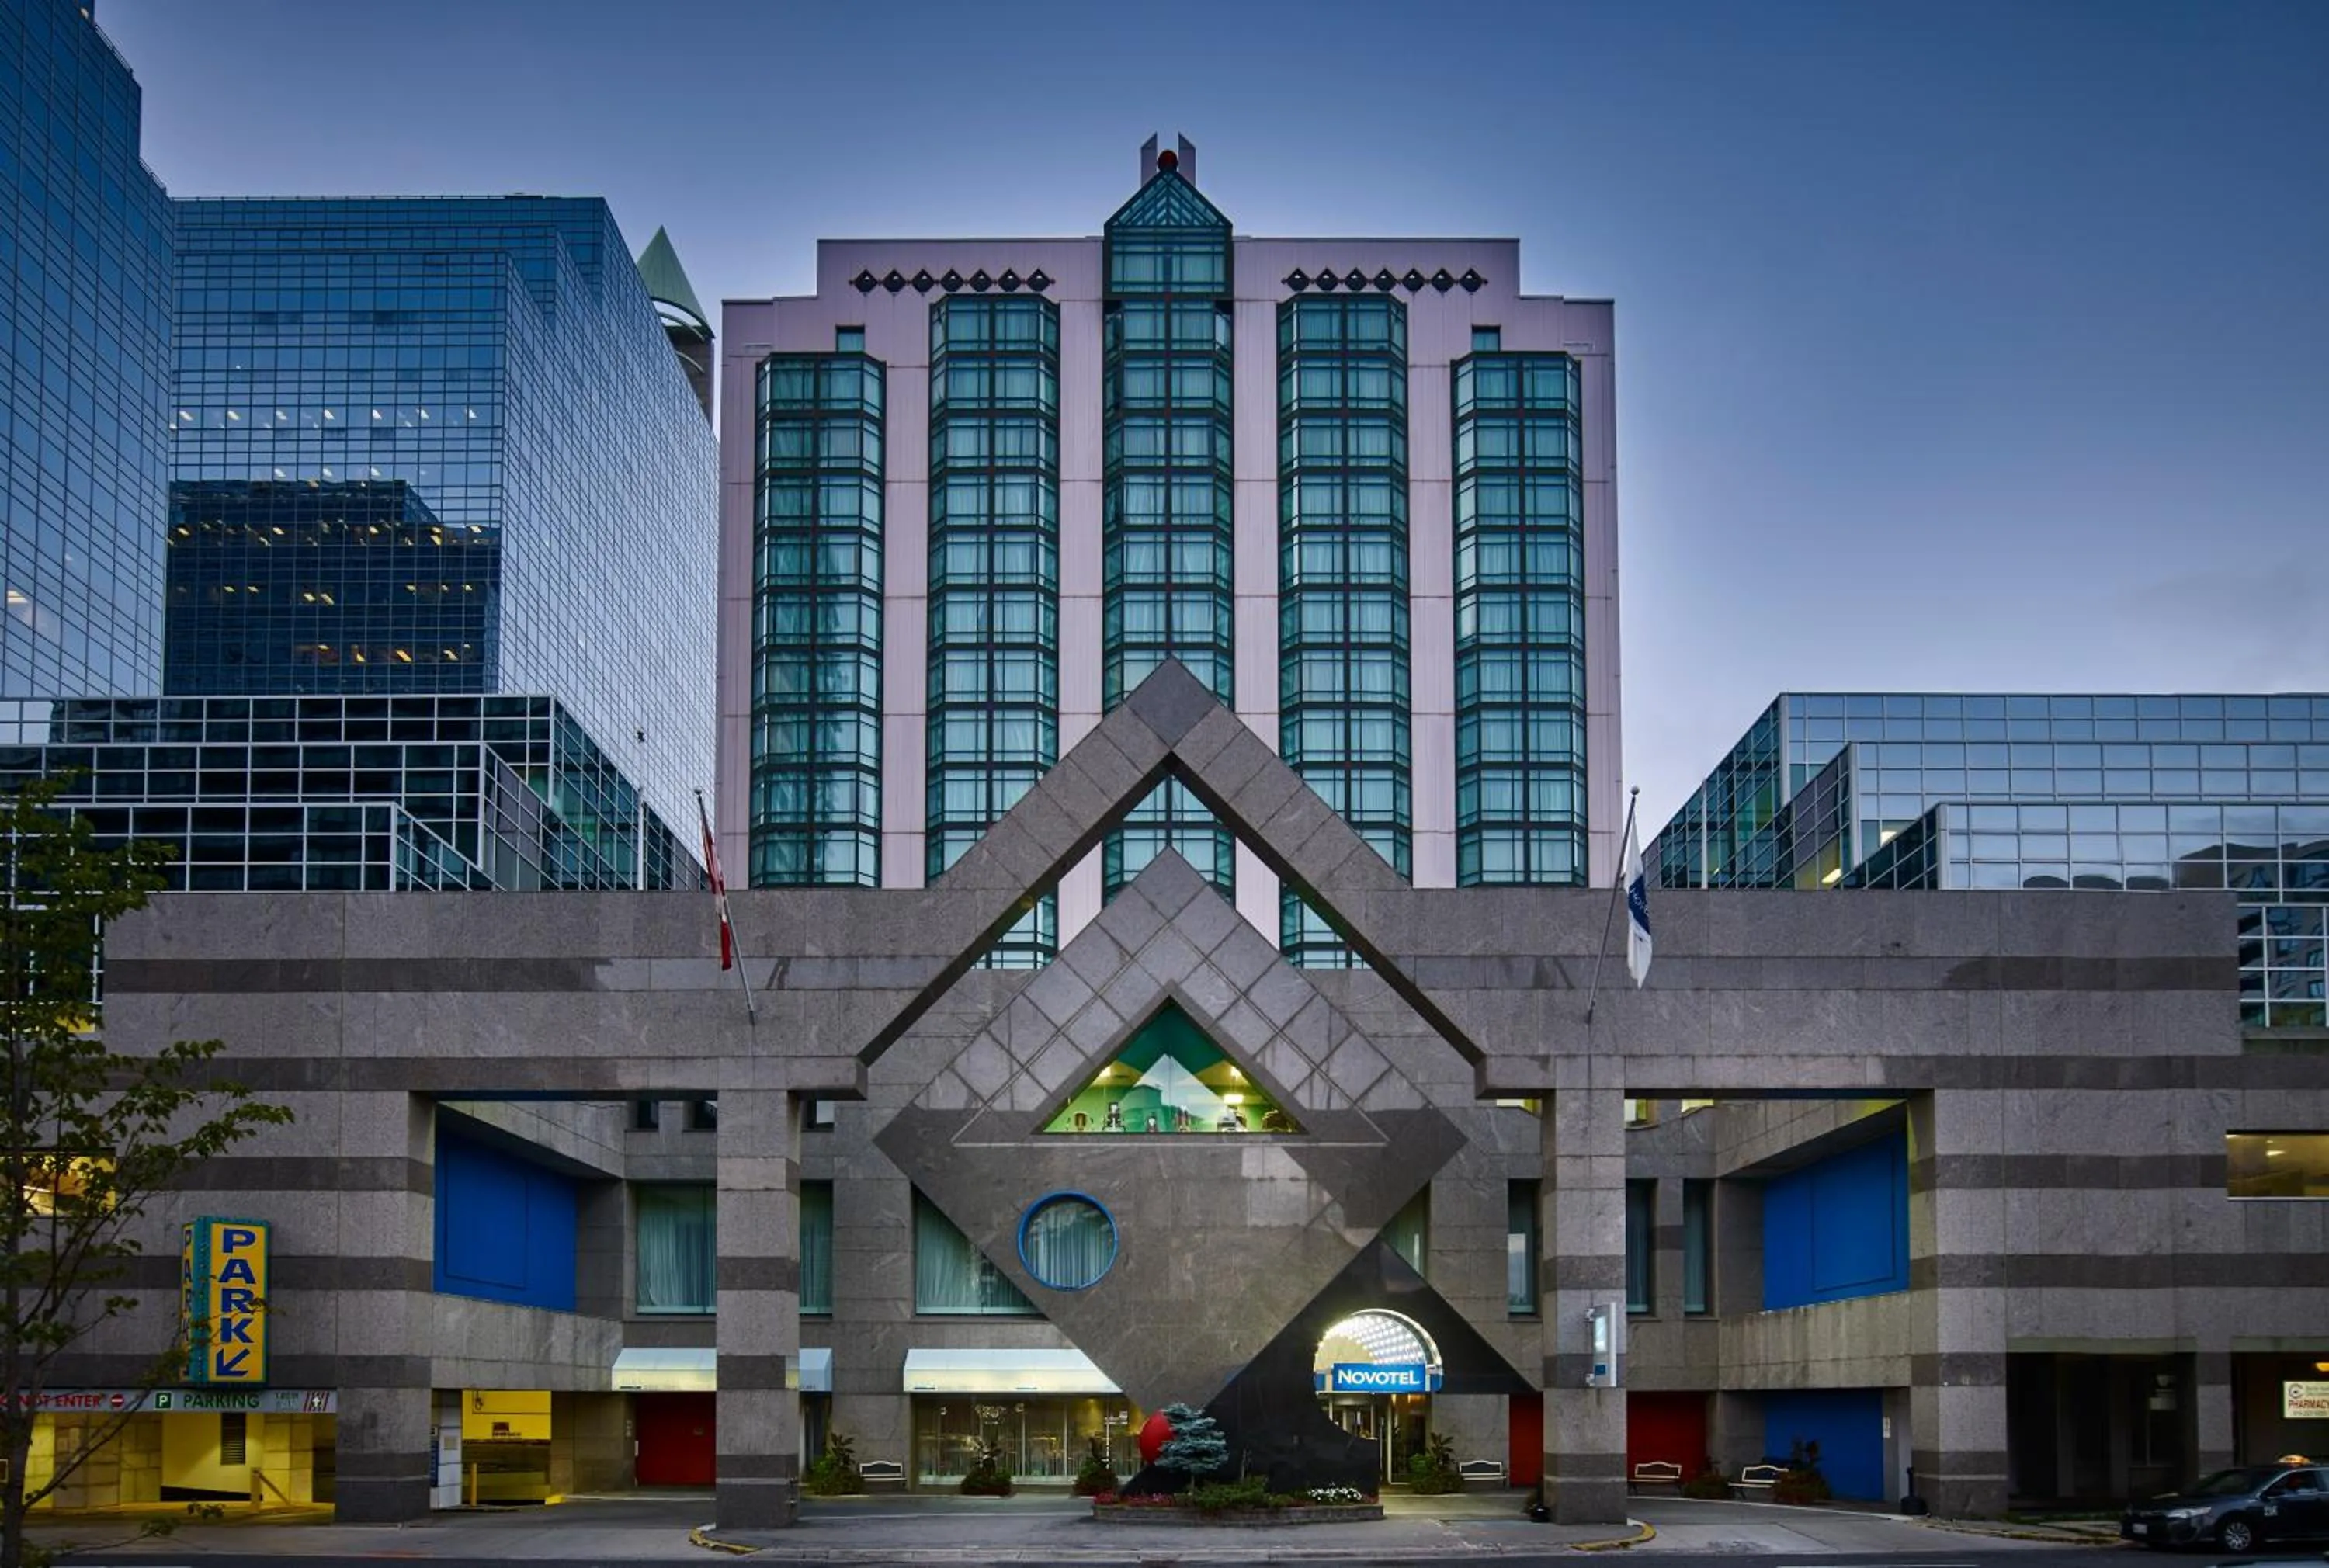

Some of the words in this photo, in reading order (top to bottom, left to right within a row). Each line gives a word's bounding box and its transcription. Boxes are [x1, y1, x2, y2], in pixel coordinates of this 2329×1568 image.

[218, 1228, 256, 1344] PARK
[1338, 1369, 1421, 1385] NOVOTEL
[158, 1395, 168, 1407] P
[183, 1393, 260, 1408] PARKING
